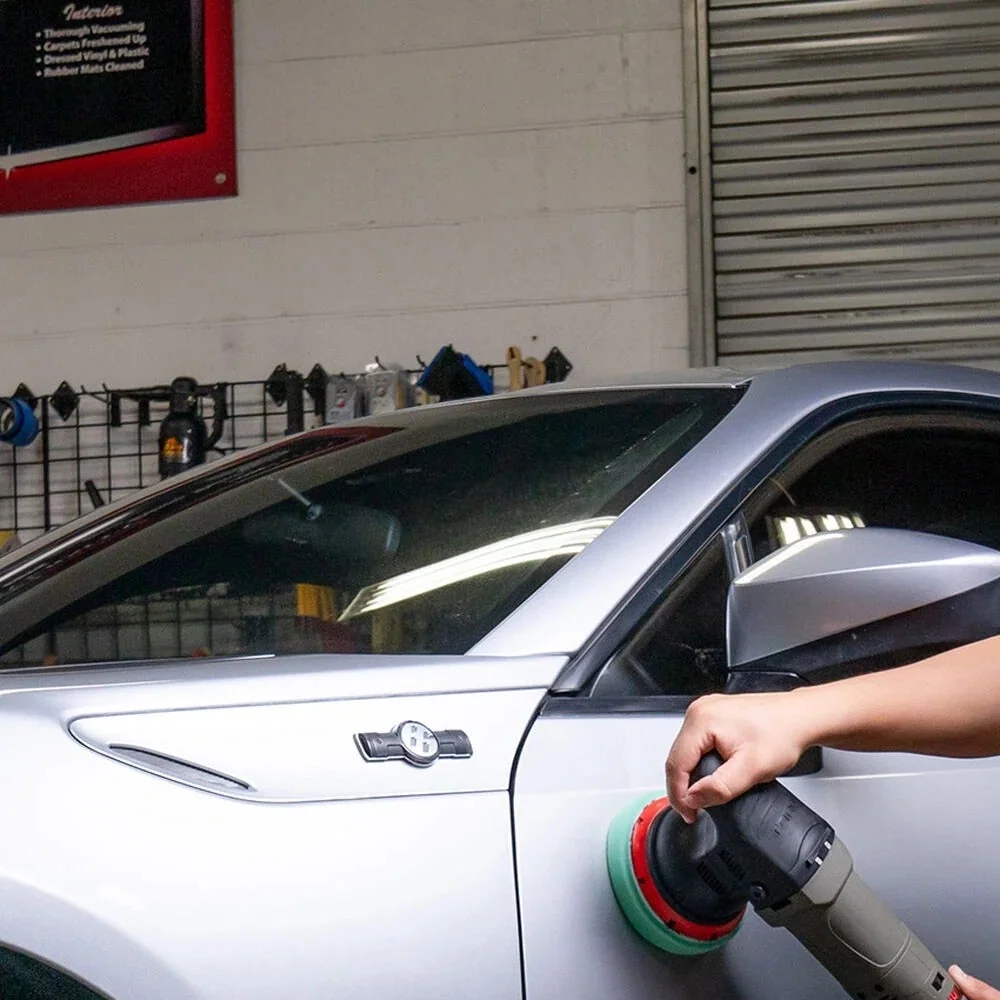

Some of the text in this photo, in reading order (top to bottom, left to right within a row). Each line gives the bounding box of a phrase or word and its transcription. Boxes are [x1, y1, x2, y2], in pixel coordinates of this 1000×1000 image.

[62, 3, 124, 21] Interior
[43, 21, 145, 38] Thorough Vacuuming
[43, 35, 147, 52] Carpets Freshened Up
[43, 47, 149, 65] Dressed Vinyl & Plastic
[43, 66, 79, 77] Rubber
[105, 59, 145, 72] Cleaned
